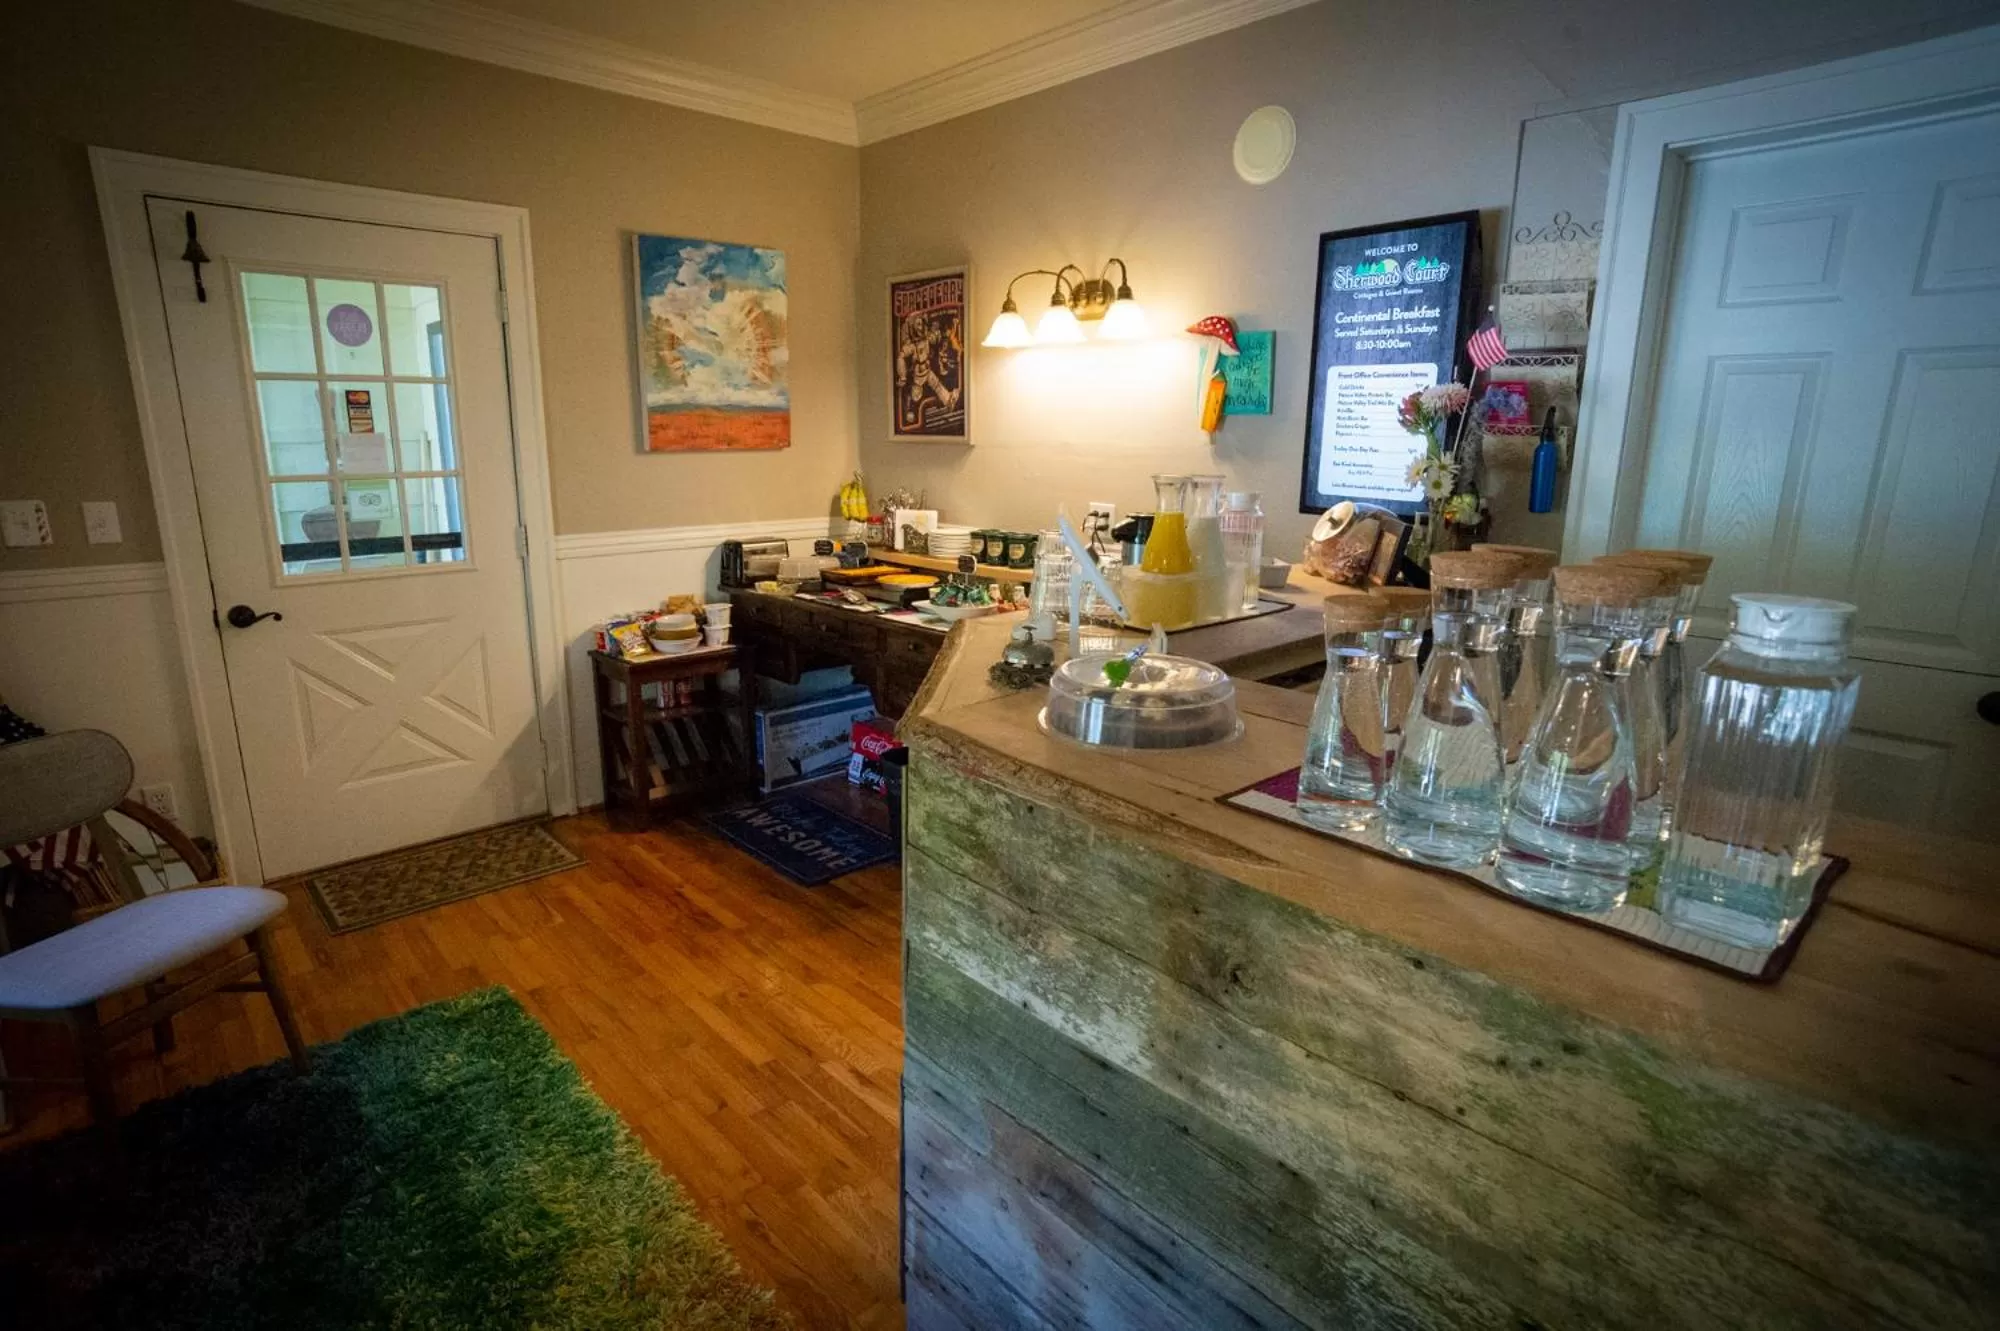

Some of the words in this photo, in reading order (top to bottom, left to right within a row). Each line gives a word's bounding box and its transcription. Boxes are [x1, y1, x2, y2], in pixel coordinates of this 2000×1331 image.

[1365, 247, 1405, 256] WELCOME
[1407, 243, 1418, 252] TO
[1332, 263, 1402, 291] Sherwood
[1403, 257, 1450, 285] Court
[1335, 308, 1390, 324] Continental
[1392, 305, 1440, 320] Breakfast
[1334, 327, 1358, 338] Served
[1359, 325, 1395, 338] Saturdays
[1396, 325, 1403, 334] &
[1404, 323, 1438, 336] Sundays
[732, 806, 857, 869] AWESOME
